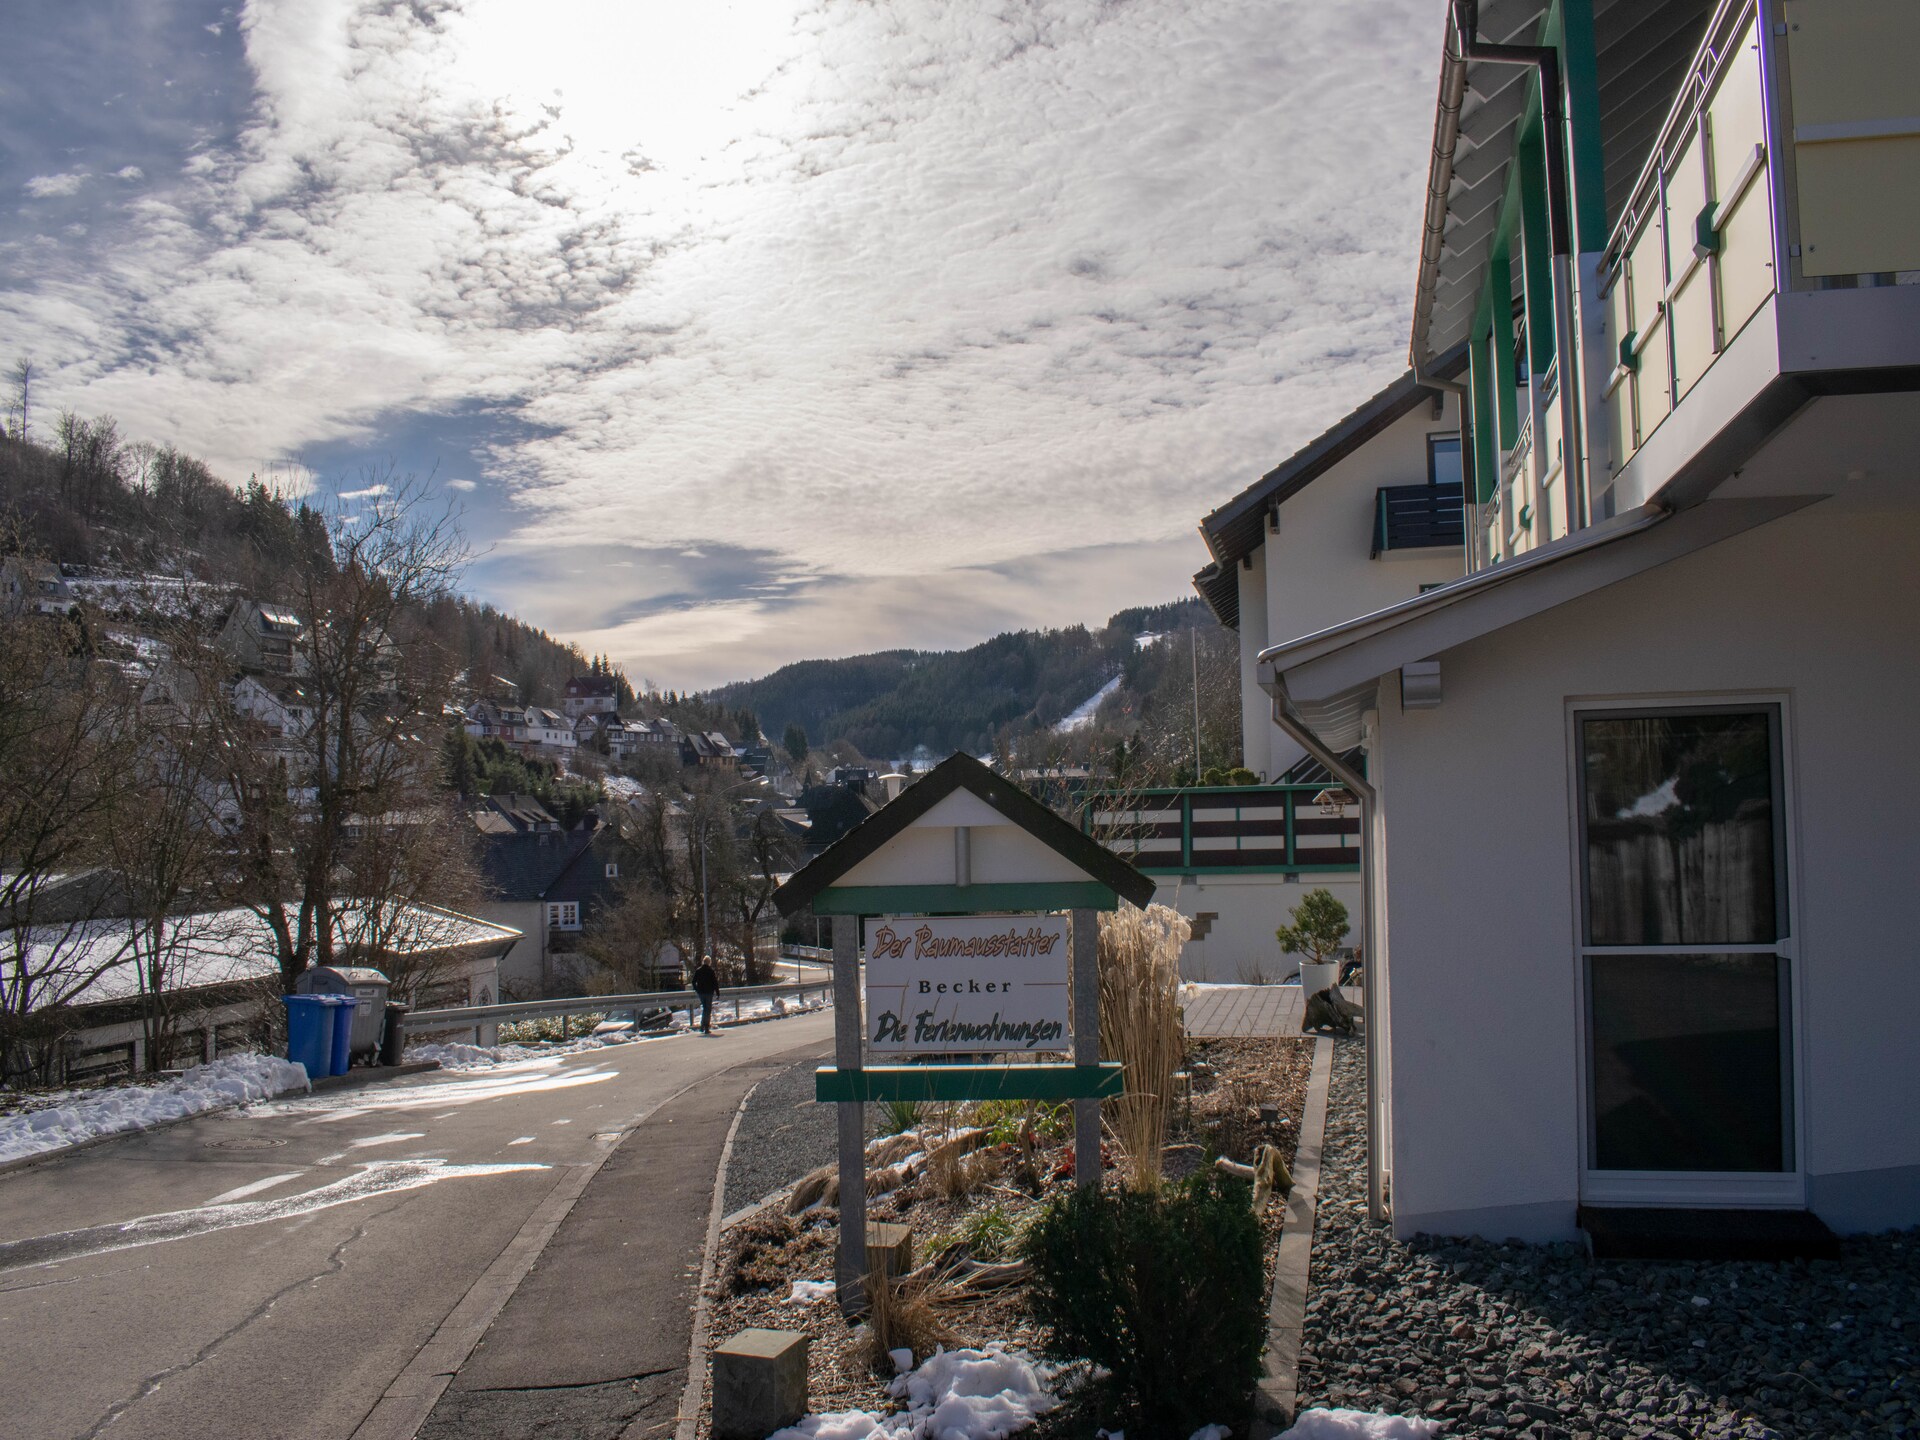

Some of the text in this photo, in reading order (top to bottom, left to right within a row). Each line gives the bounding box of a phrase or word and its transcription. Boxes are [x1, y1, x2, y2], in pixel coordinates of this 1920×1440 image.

[872, 924, 1060, 960] Der Raumausstatter
[918, 979, 1012, 994] Becker
[873, 1009, 1062, 1048] Die Ferienwohnungen
